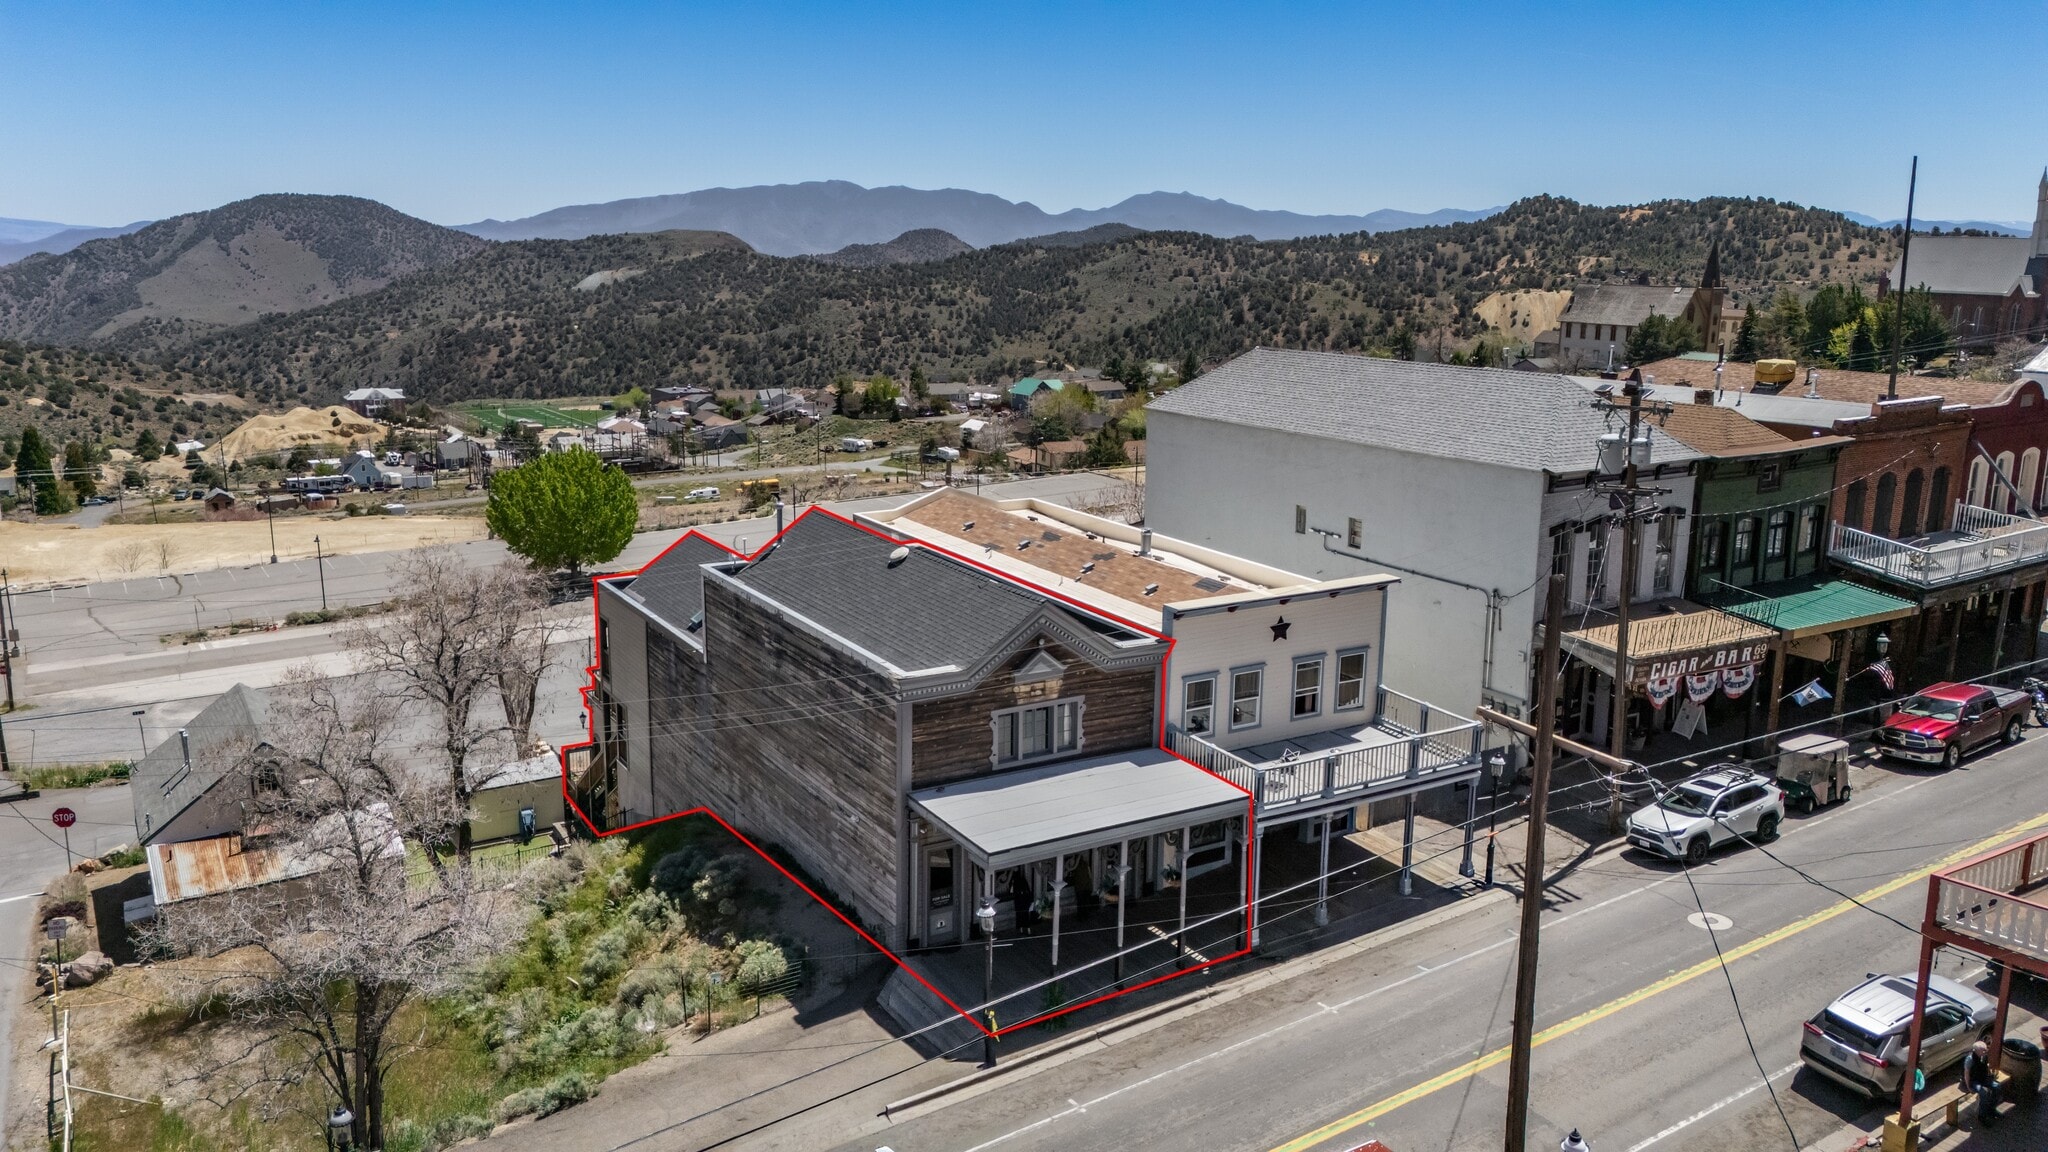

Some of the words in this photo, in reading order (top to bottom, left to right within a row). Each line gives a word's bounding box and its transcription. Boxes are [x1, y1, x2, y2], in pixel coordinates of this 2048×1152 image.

[1754, 643, 1768, 655] 69
[1650, 657, 1699, 680] CIGAR
[1714, 646, 1752, 667] BAR
[54, 813, 74, 822] STOP
